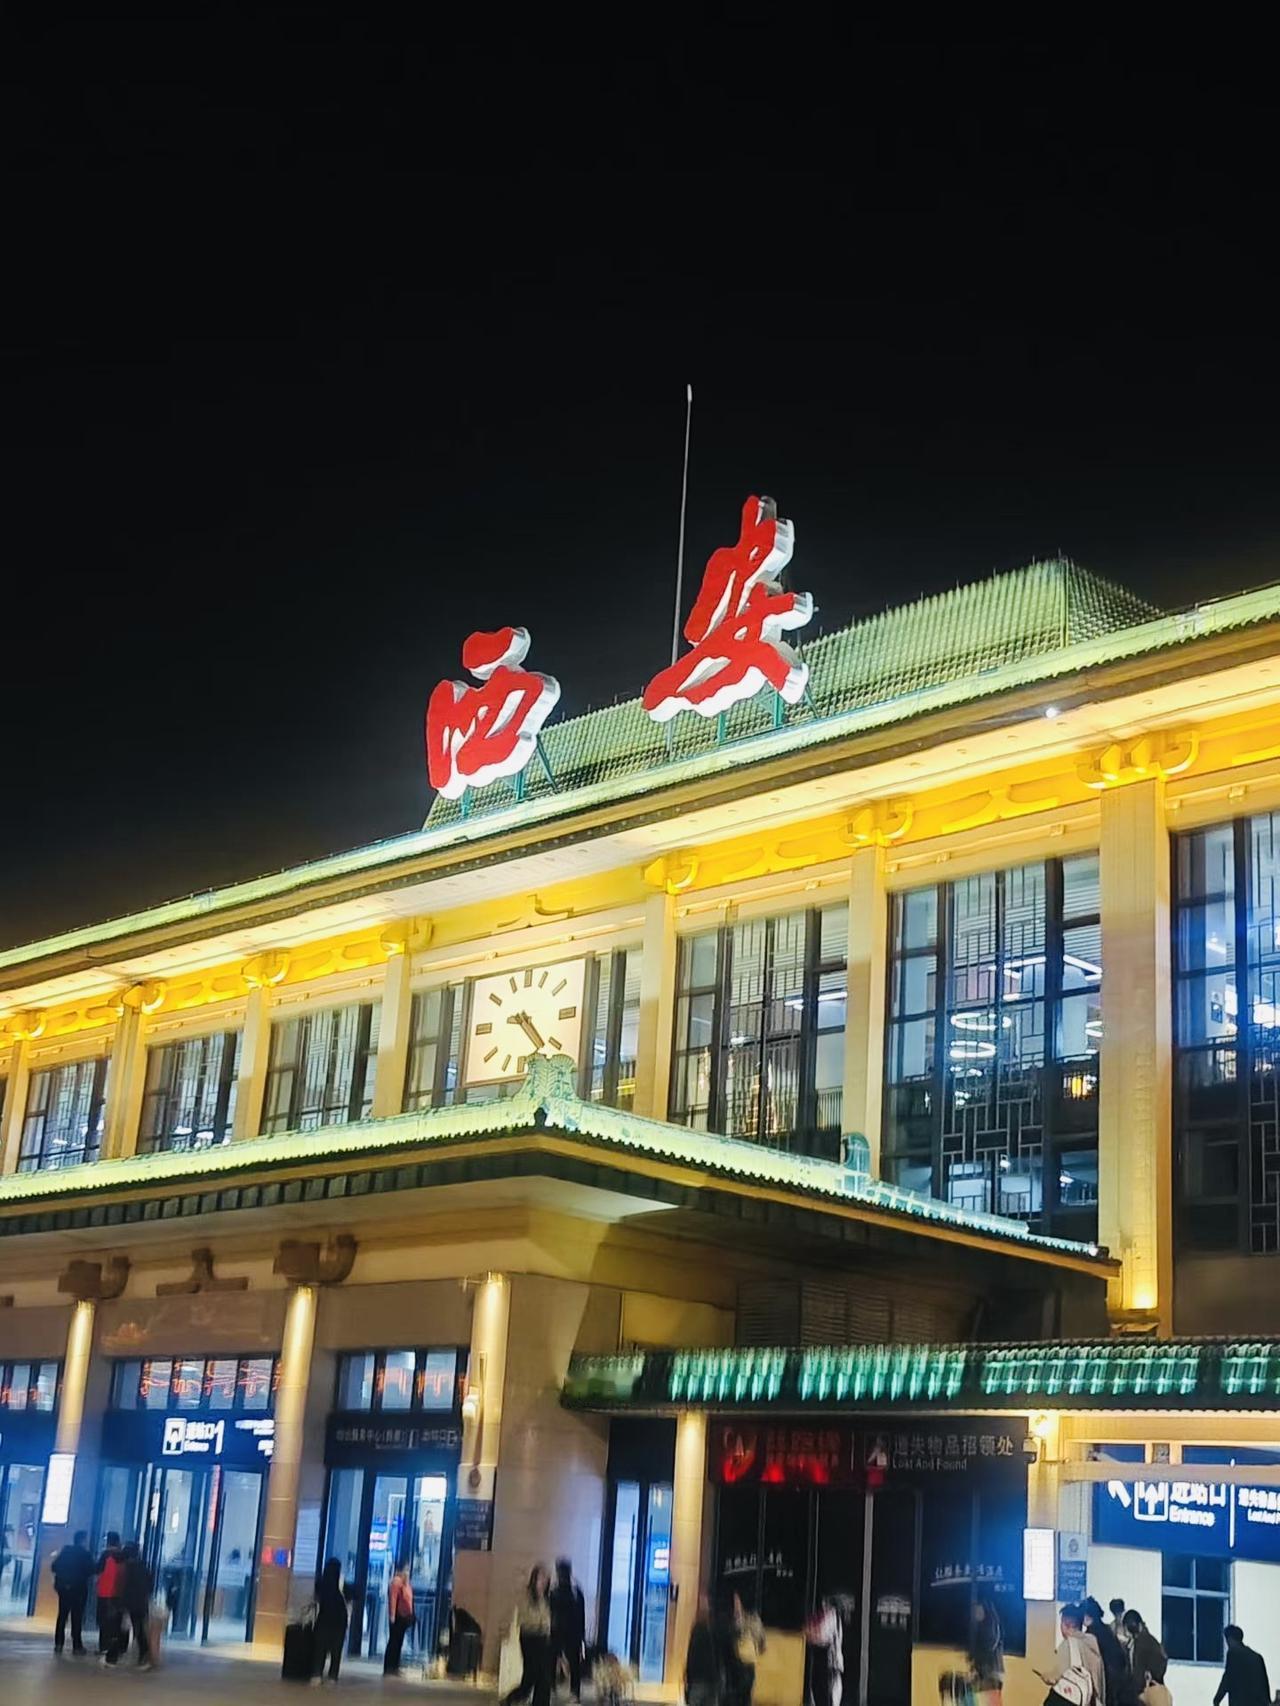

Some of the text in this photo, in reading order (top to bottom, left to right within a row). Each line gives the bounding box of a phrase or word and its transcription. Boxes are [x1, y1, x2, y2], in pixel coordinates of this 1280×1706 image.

[426, 495, 814, 799] 西安
[894, 1434, 1014, 1457] 遗失物品招领处
[1169, 1504, 1216, 1527] Entrance
